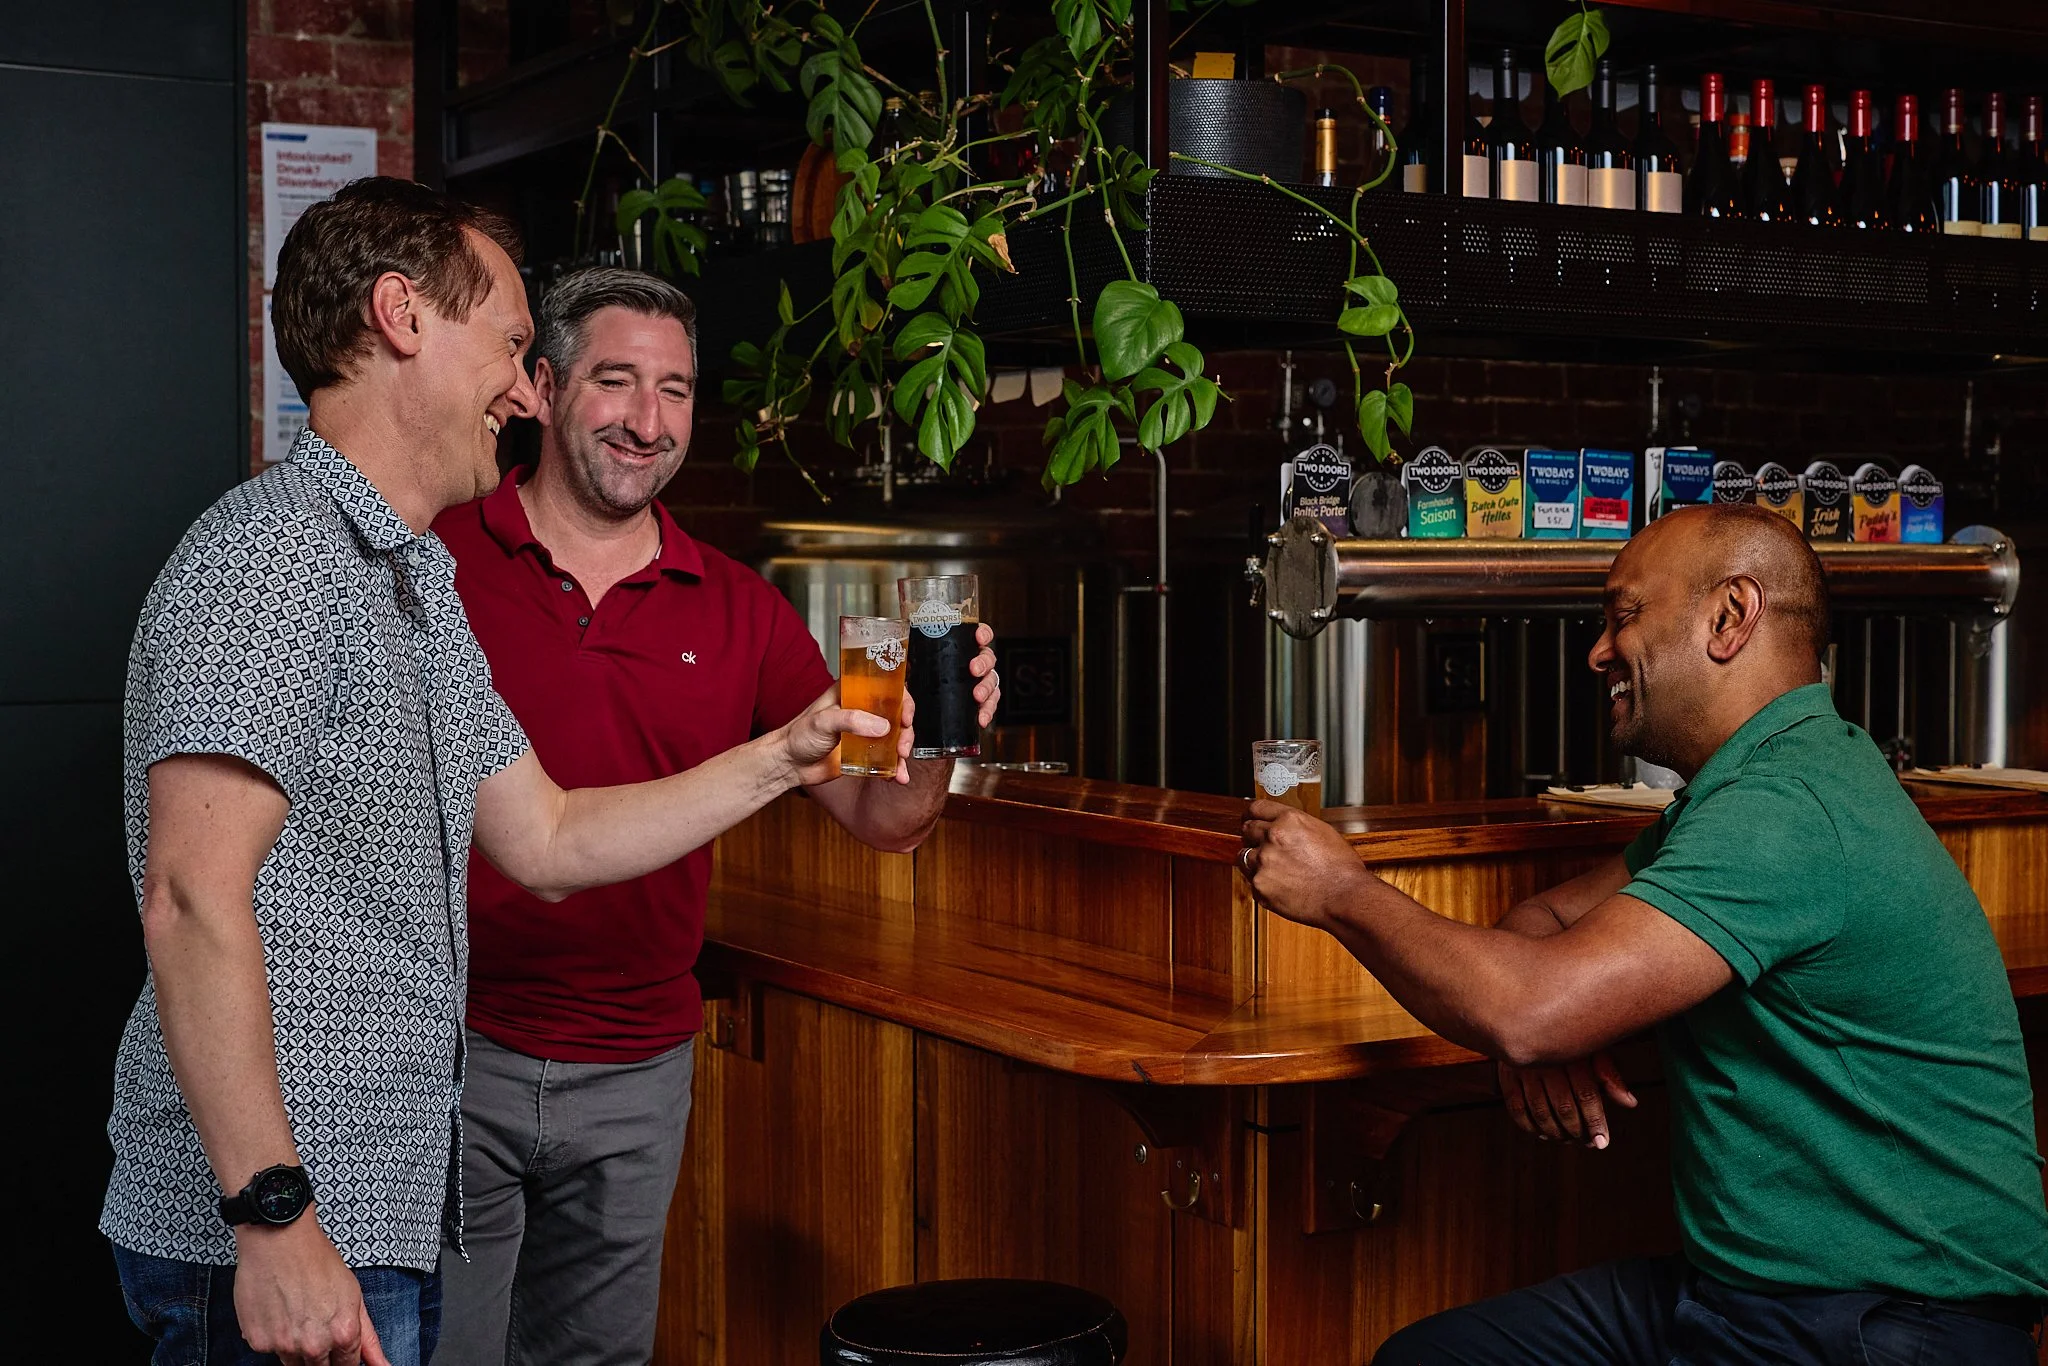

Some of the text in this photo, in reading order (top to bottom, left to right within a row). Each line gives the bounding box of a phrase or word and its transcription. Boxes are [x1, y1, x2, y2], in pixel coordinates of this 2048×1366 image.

[277, 163, 320, 174] Drunk?
[1298, 463, 1348, 476] TWO DOORS
[1410, 466, 1460, 476] TWO DOORS
[1469, 466, 1516, 476] TWO DOORS
[1727, 479, 1753, 488] DOORS
[1773, 480, 1797, 489] DOORS
[1807, 479, 1848, 490] TWO DOORS
[1856, 481, 1896, 491] TWO DOORS
[1903, 484, 1942, 494] TWO DOORS
[1300, 495, 1341, 507] Black Bridge
[1417, 497, 1454, 510] Farmhouse
[1293, 505, 1348, 518] Baltic Porter
[1420, 508, 1457, 525] Saison
[1811, 507, 1841, 523] Irish
[1481, 510, 1512, 527] Helles
[1810, 521, 1839, 538] Stout
[912, 614, 958, 624] TWO DOORS
